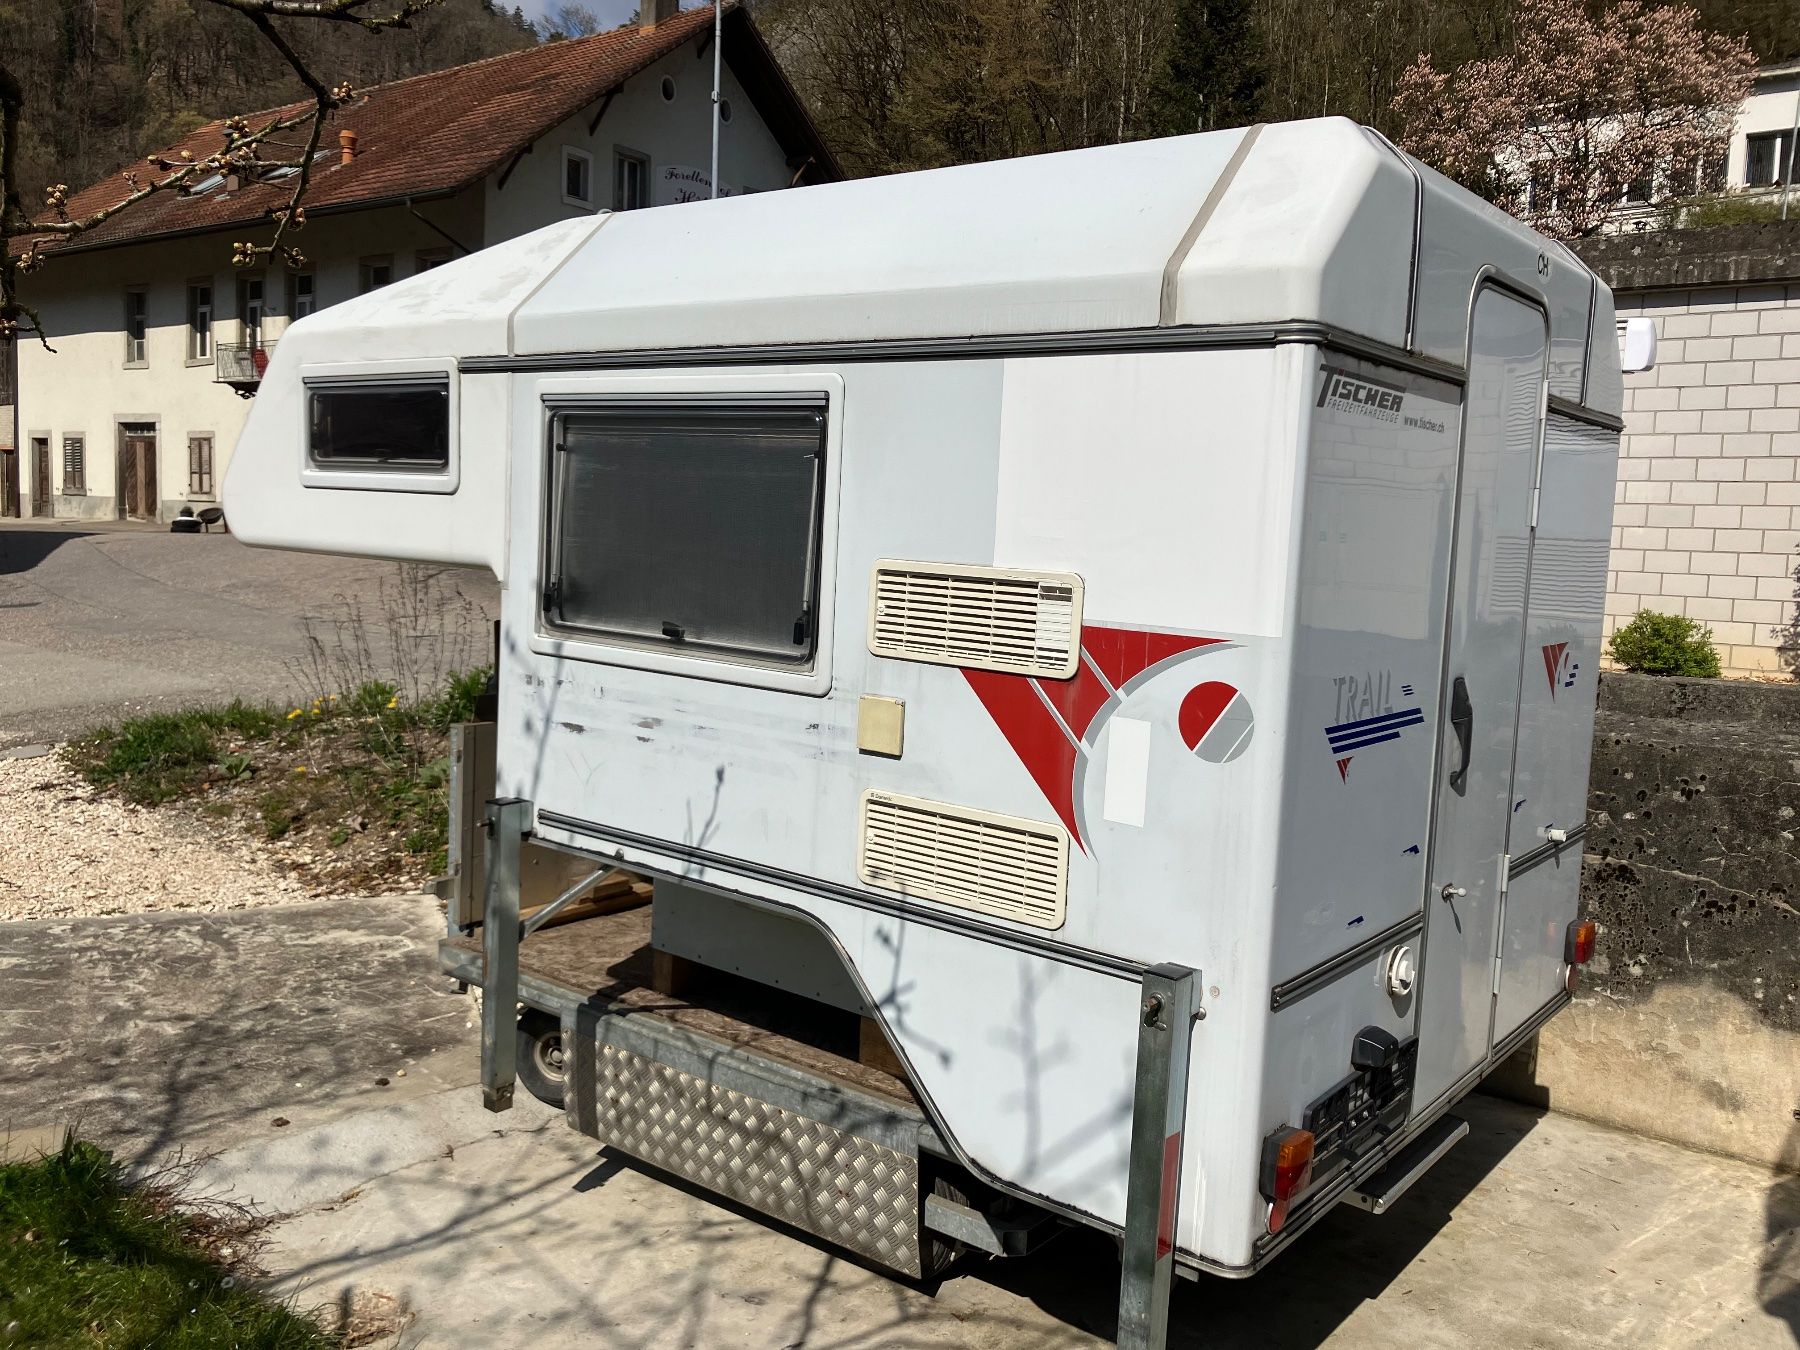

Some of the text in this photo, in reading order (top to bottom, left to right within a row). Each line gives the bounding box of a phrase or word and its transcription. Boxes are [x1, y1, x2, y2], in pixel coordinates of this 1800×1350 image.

[1537, 253, 1549, 277] CH
[1316, 363, 1407, 413] TISCHER
[1326, 398, 1400, 424] FREIZEITFAHRZEUGE
[1403, 415, 1445, 434] www.tischer.ch
[1333, 669, 1394, 725] TRAIL
